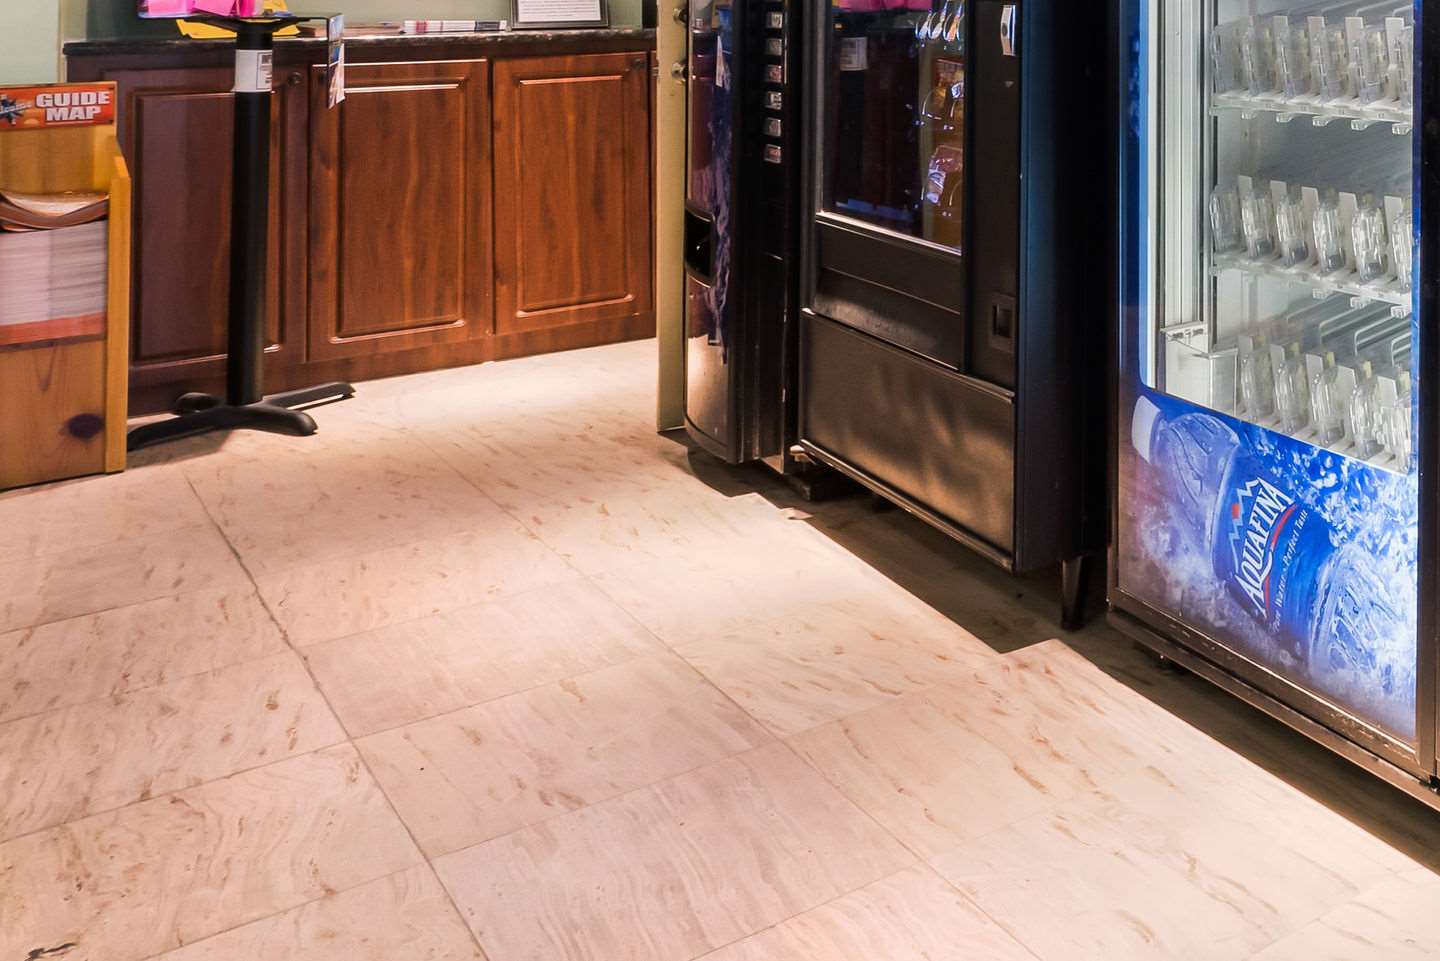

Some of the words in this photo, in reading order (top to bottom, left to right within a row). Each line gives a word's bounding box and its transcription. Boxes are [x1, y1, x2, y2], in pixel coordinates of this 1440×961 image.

[36, 91, 111, 108] GUIDE
[46, 106, 101, 121] MAP
[1234, 476, 1296, 620] AQUAFINA
